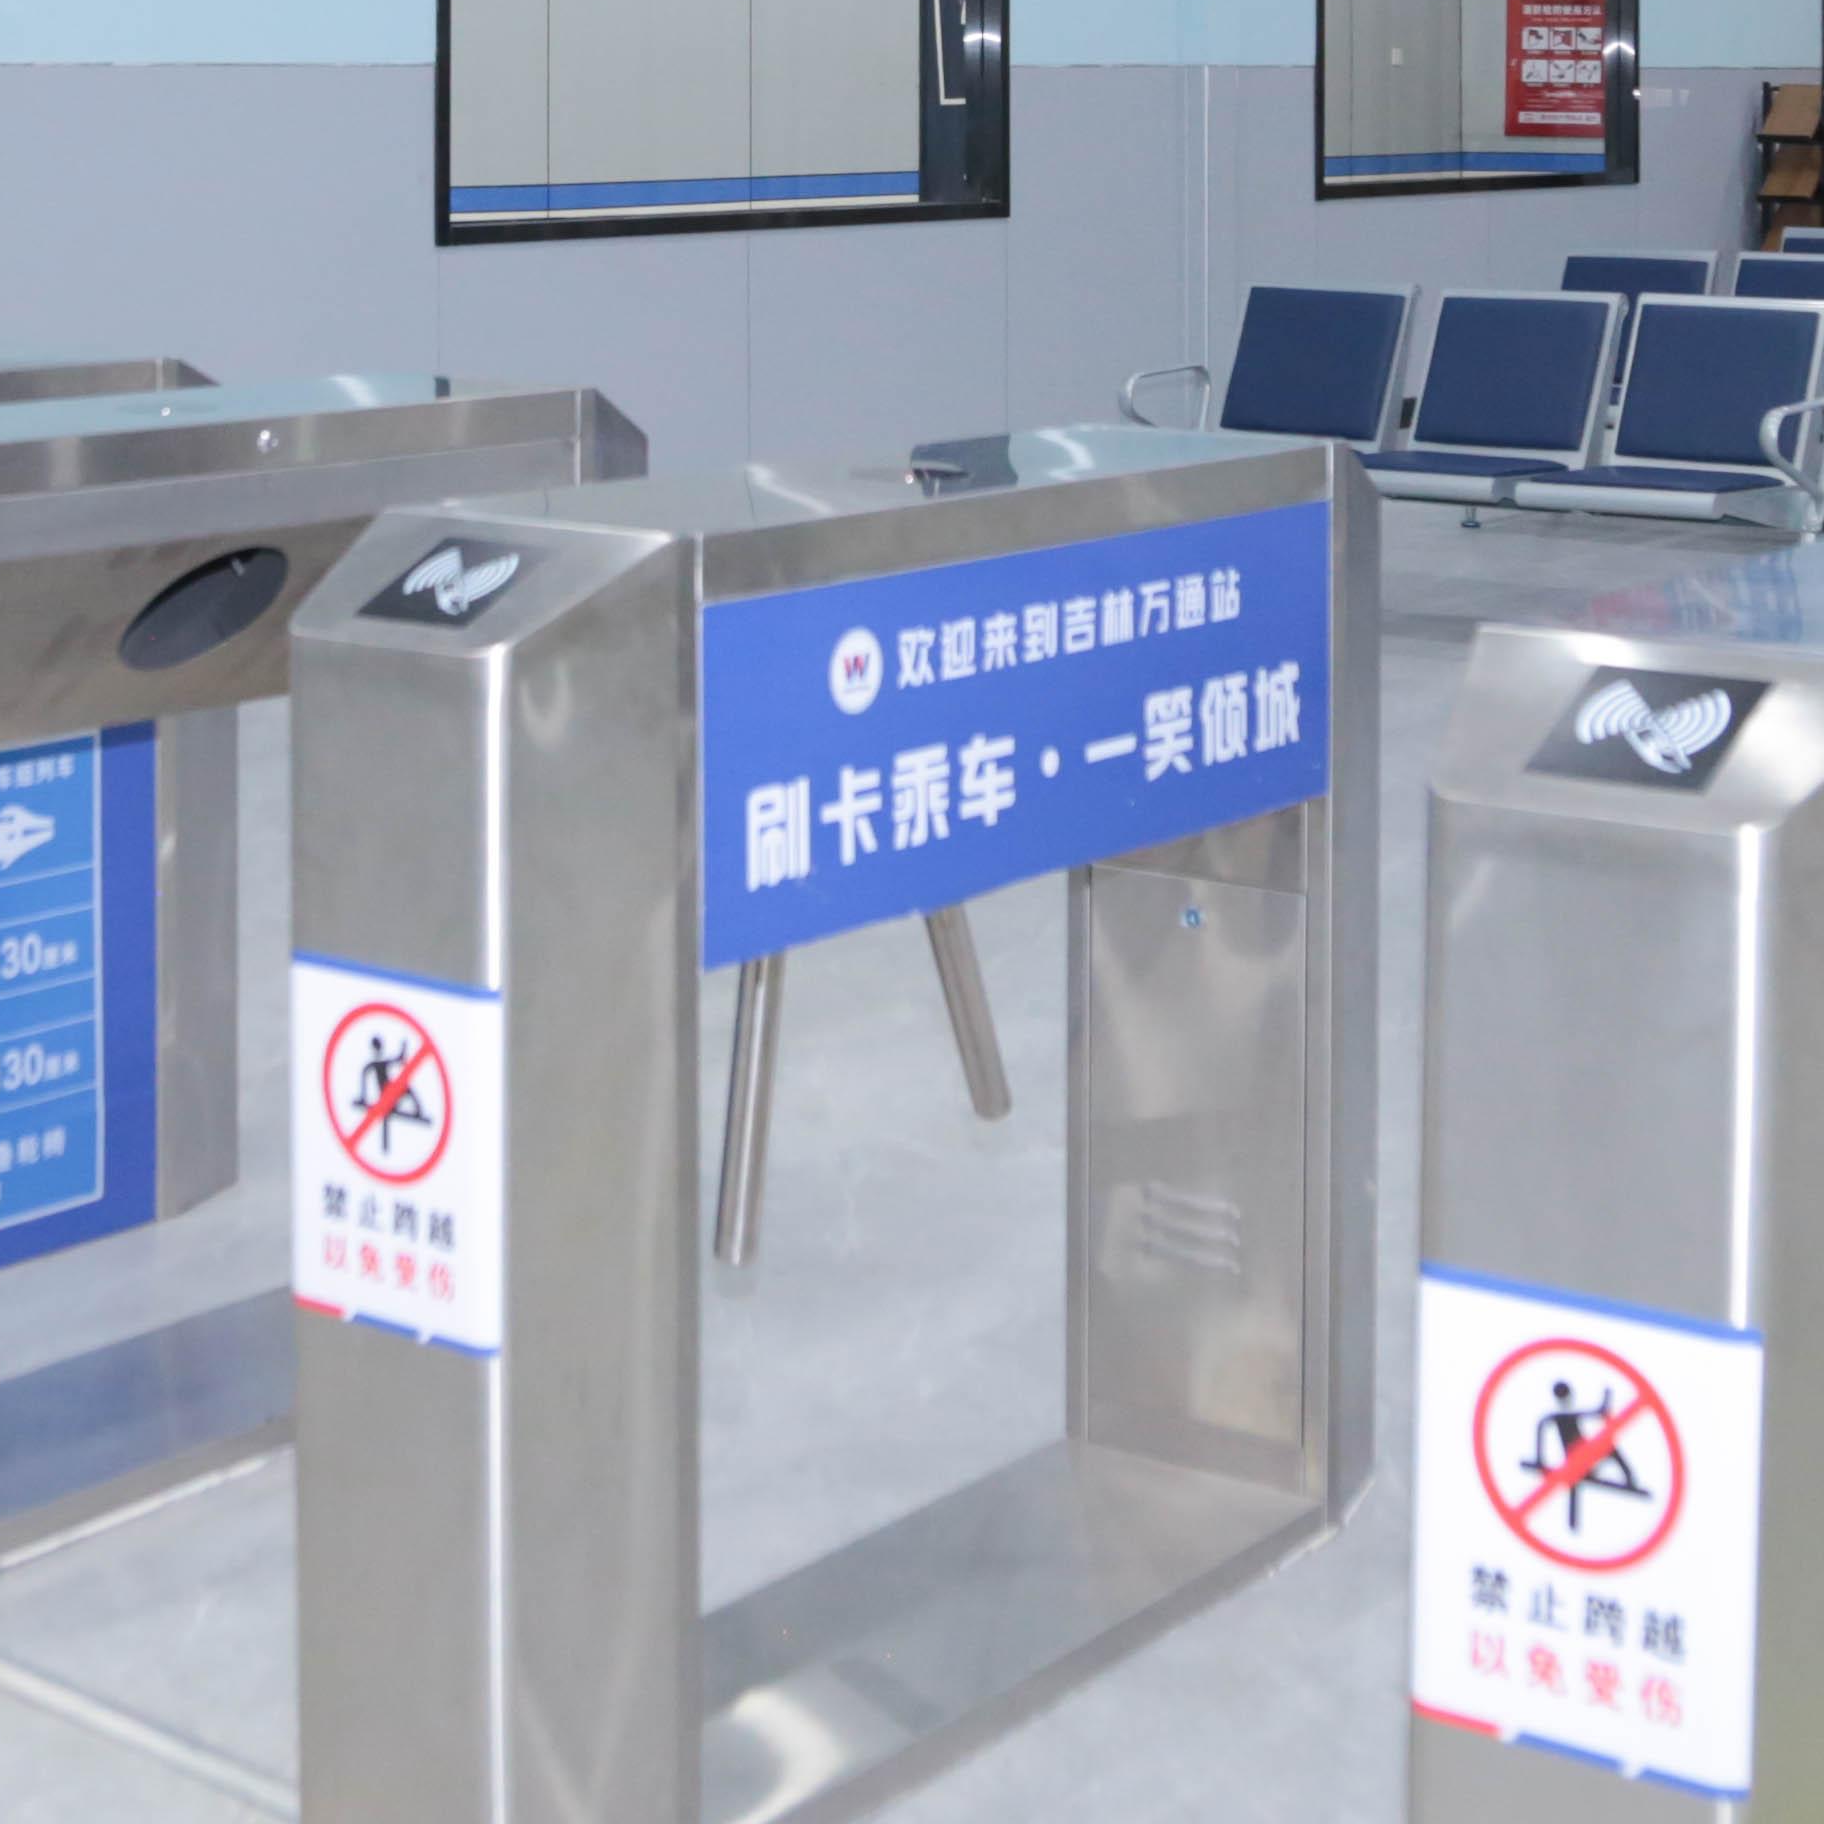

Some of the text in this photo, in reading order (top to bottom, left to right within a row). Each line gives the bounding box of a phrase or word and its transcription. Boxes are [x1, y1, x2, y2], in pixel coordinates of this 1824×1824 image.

[897, 567, 1241, 689] 欢迎来到吉林万通站
[323, 1182, 456, 1252] 禁止跨越
[1470, 1565, 1688, 1664] 禁止跨越
[1469, 1629, 1684, 1729] 以免受伤
